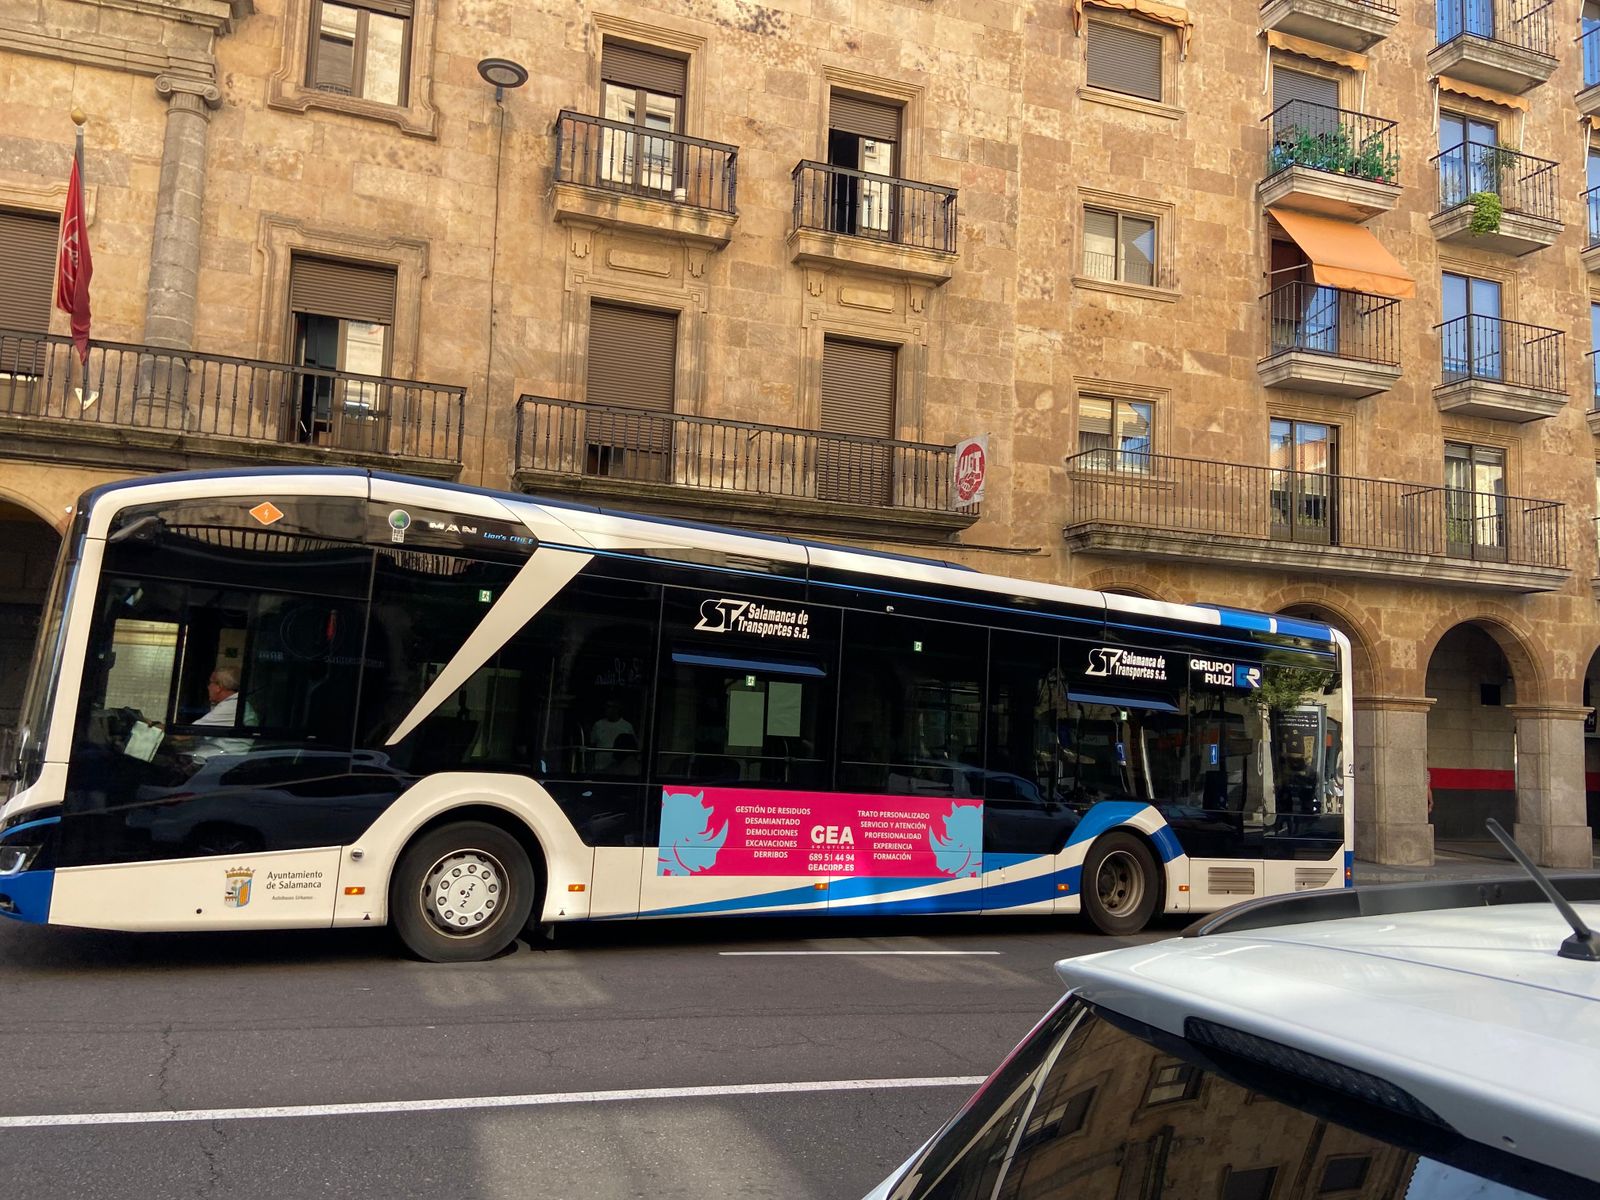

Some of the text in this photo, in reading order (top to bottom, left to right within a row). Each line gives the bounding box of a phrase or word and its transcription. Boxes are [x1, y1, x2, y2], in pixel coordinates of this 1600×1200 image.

[960, 450, 981, 478] UGT
[428, 522, 478, 534] MAN
[483, 532, 507, 541] Lion's
[748, 603, 809, 625] Salamanca de
[738, 616, 810, 639] Transportes s.a.
[1121, 651, 1166, 668] Salamanca de
[1115, 662, 1167, 680] Transportes s.a.
[1190, 659, 1232, 674] GRUPO
[1204, 673, 1232, 686] RUIZ
[735, 804, 811, 815] GESTIÓN DE RESIDUOS
[857, 810, 930, 819] TRATO PERSONALIZADO
[745, 817, 801, 826] DESAMIANTADO
[860, 821, 889, 829] SERVICIO
[895, 821, 927, 830] ATENCIÓN
[746, 828, 799, 837] DEMOLICIONES
[810, 825, 855, 845] GEA
[864, 831, 922, 840] PROFESIONALIDAD
[745, 839, 798, 848] EXCAVACIONES
[873, 842, 913, 850] EXPERIENCIA
[753, 851, 788, 859] DERRIBOS
[808, 853, 855, 862] 689 51 44 94
[873, 852, 912, 861] FORMACIÓN
[808, 863, 855, 872] GEACORP.ES
[267, 870, 323, 881] Ayuntamiento
[266, 880, 322, 890] de Salamanca
